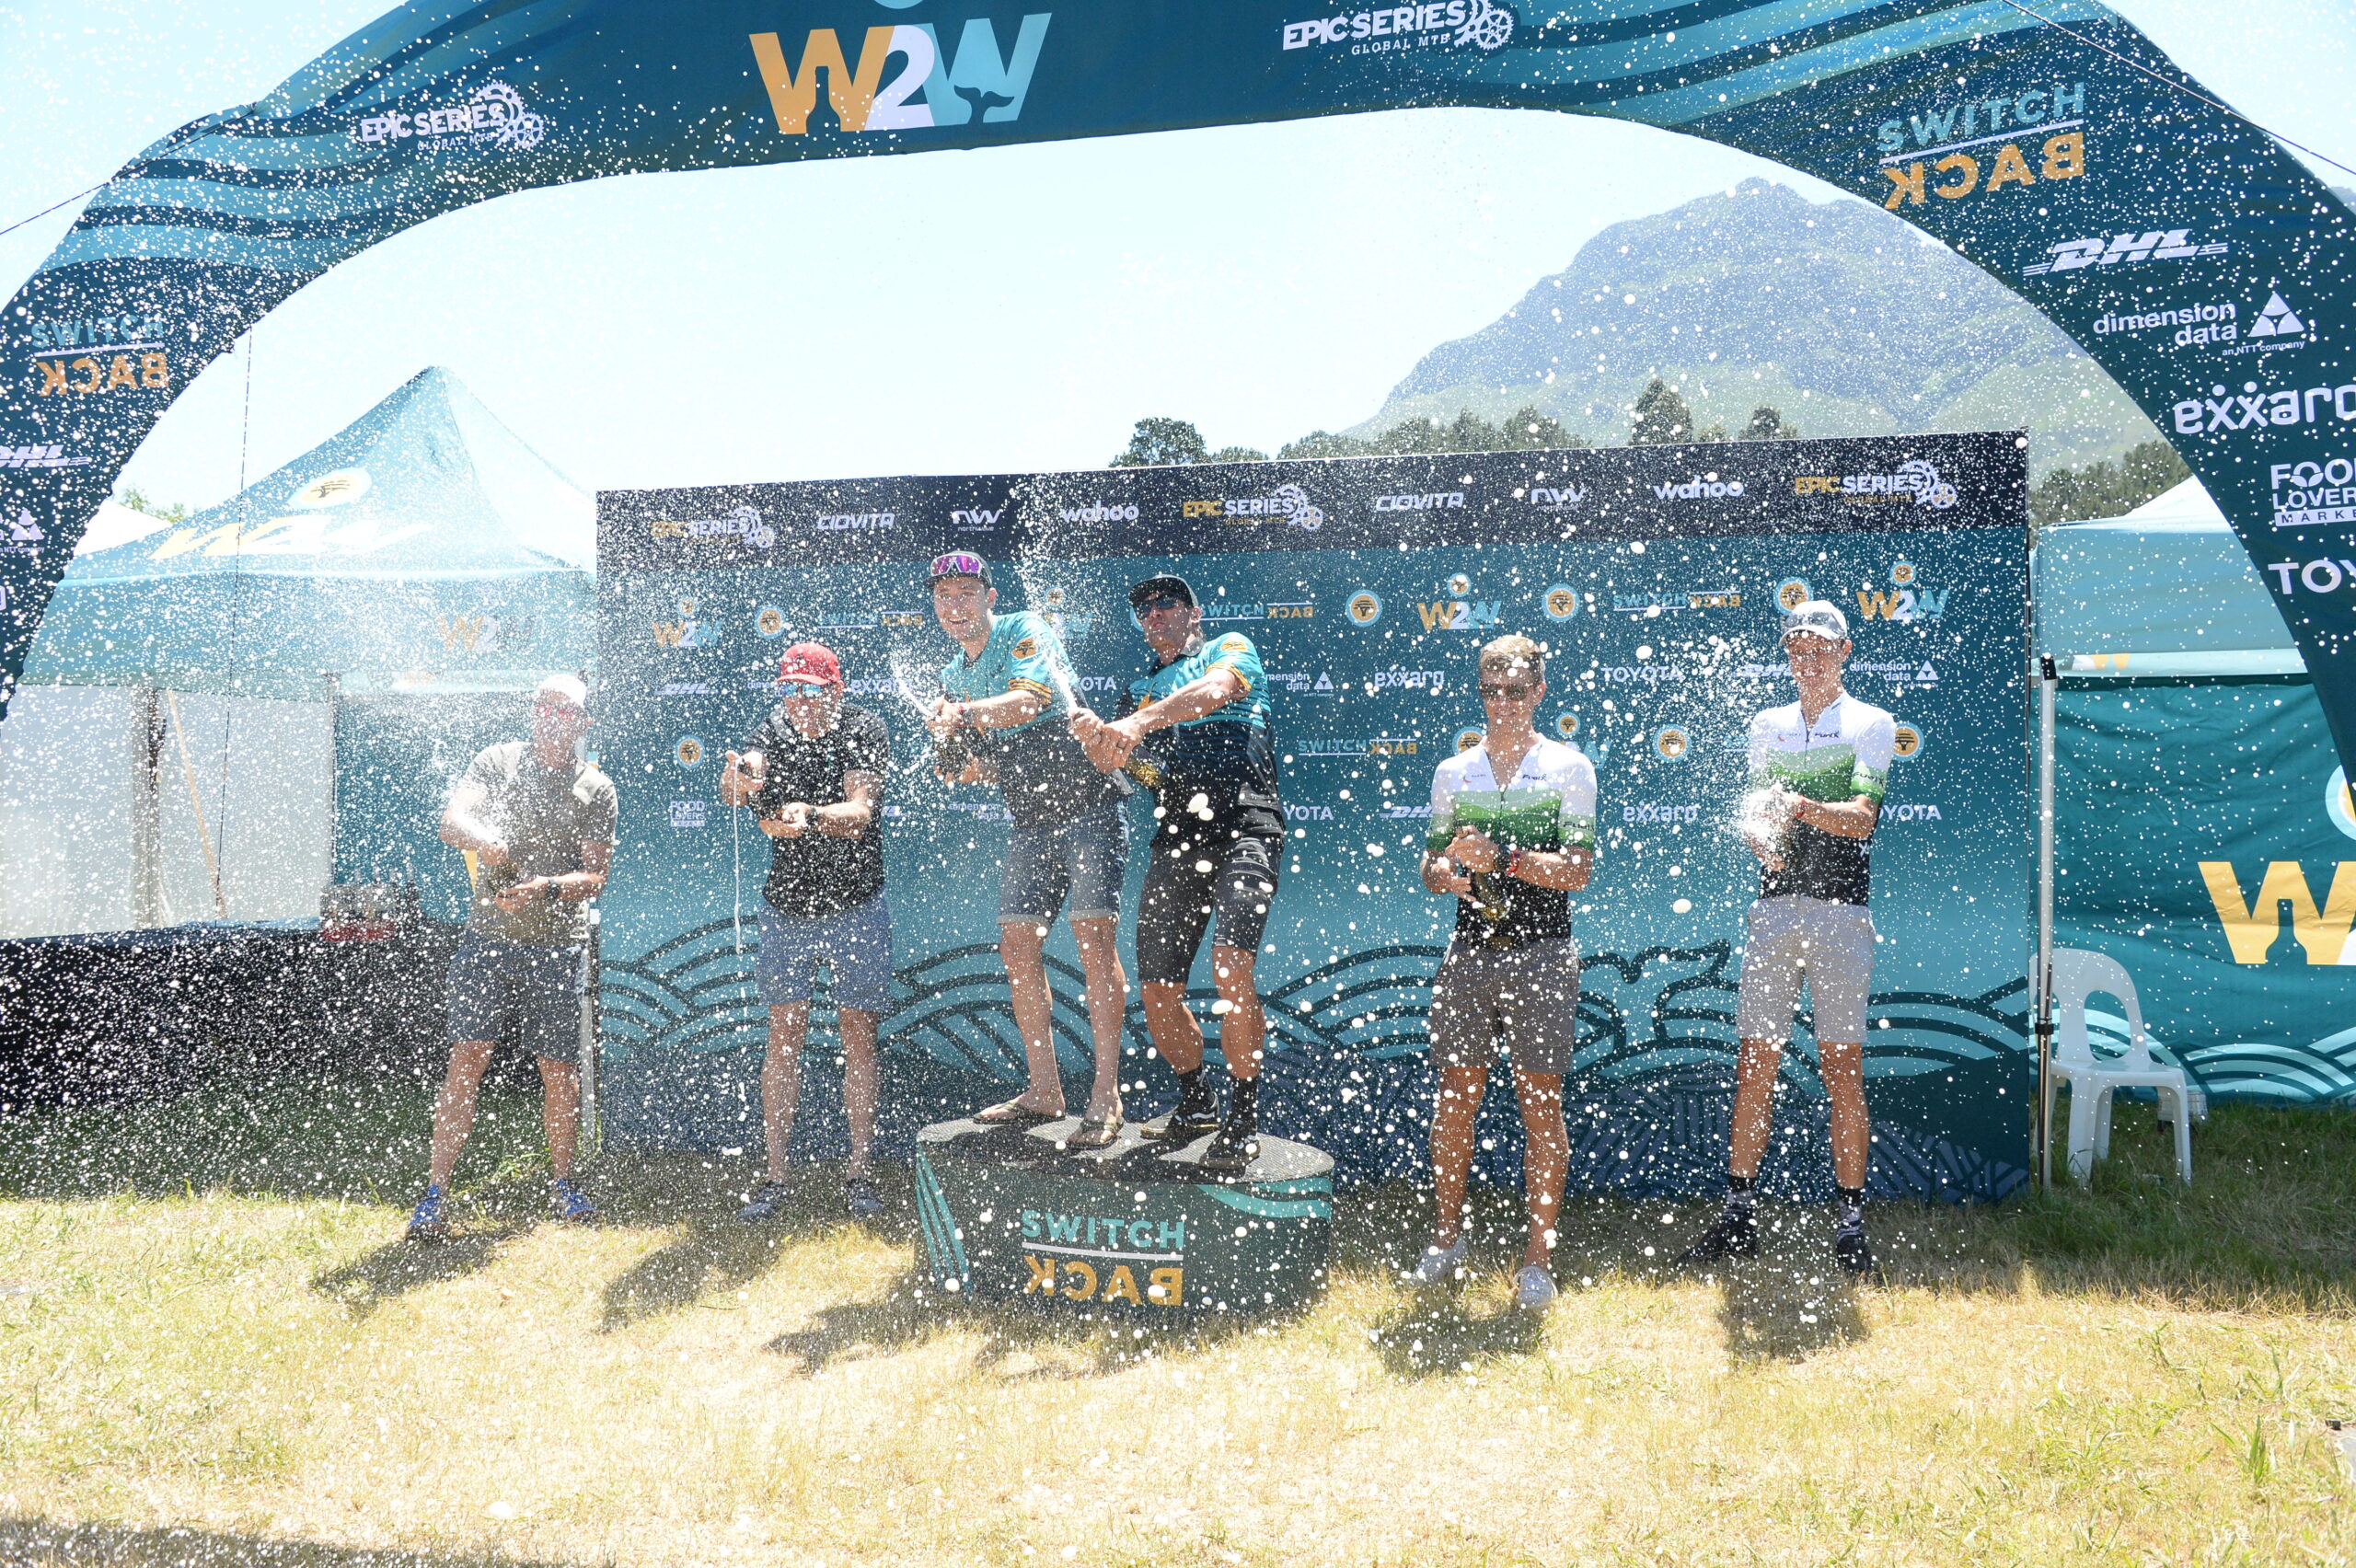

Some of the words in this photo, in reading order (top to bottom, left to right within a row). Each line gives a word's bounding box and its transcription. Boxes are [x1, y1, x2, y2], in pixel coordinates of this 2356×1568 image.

[1283, 16, 1349, 51] EPIC
[1351, 0, 1466, 40] SERIES
[1351, 38, 1411, 55] GLOBAL
[1418, 34, 1449, 47] MTB
[749, 12, 1052, 135] W2W
[361, 113, 413, 143] EPIC
[414, 102, 505, 136] SERIES
[1877, 82, 2084, 152] SWITCH
[417, 138, 464, 151] GLOBAL
[469, 133, 493, 145] MTB
[2050, 228, 2200, 272] DHL
[2093, 302, 2236, 334] dimension
[31, 314, 164, 349] SWITCH
[2175, 321, 2237, 346] data
[2222, 348, 2235, 356] an
[2236, 343, 2257, 354] NTT
[2259, 340, 2305, 353] company
[1796, 477, 1840, 495] EPIC
[1842, 474, 1922, 494] SERIES
[2270, 458, 2356, 490] FOO
[1653, 475, 1744, 500] wahoo
[1061, 500, 1140, 523] wahoo
[1183, 500, 1224, 518] EPIC
[1225, 498, 1292, 516] SERIES
[2281, 509, 2356, 524] MARK
[1613, 592, 1689, 607] SWITCH
[1856, 590, 1949, 620] W2W
[1417, 600, 1502, 630] W2W
[653, 620, 721, 647] W2W
[1601, 665, 1684, 684] TOYOTA
[1849, 659, 1911, 672] dimension
[1080, 676, 1117, 692] OTA
[1265, 672, 1311, 683] mension
[1286, 681, 1311, 691] data
[1883, 671, 1911, 682] data
[1299, 739, 1367, 753] SWITCH
[1284, 805, 1334, 822] YOTA
[1390, 805, 1433, 818] DH
[1881, 804, 1943, 822] YOTA
[1022, 1208, 1184, 1250] SWITCH
